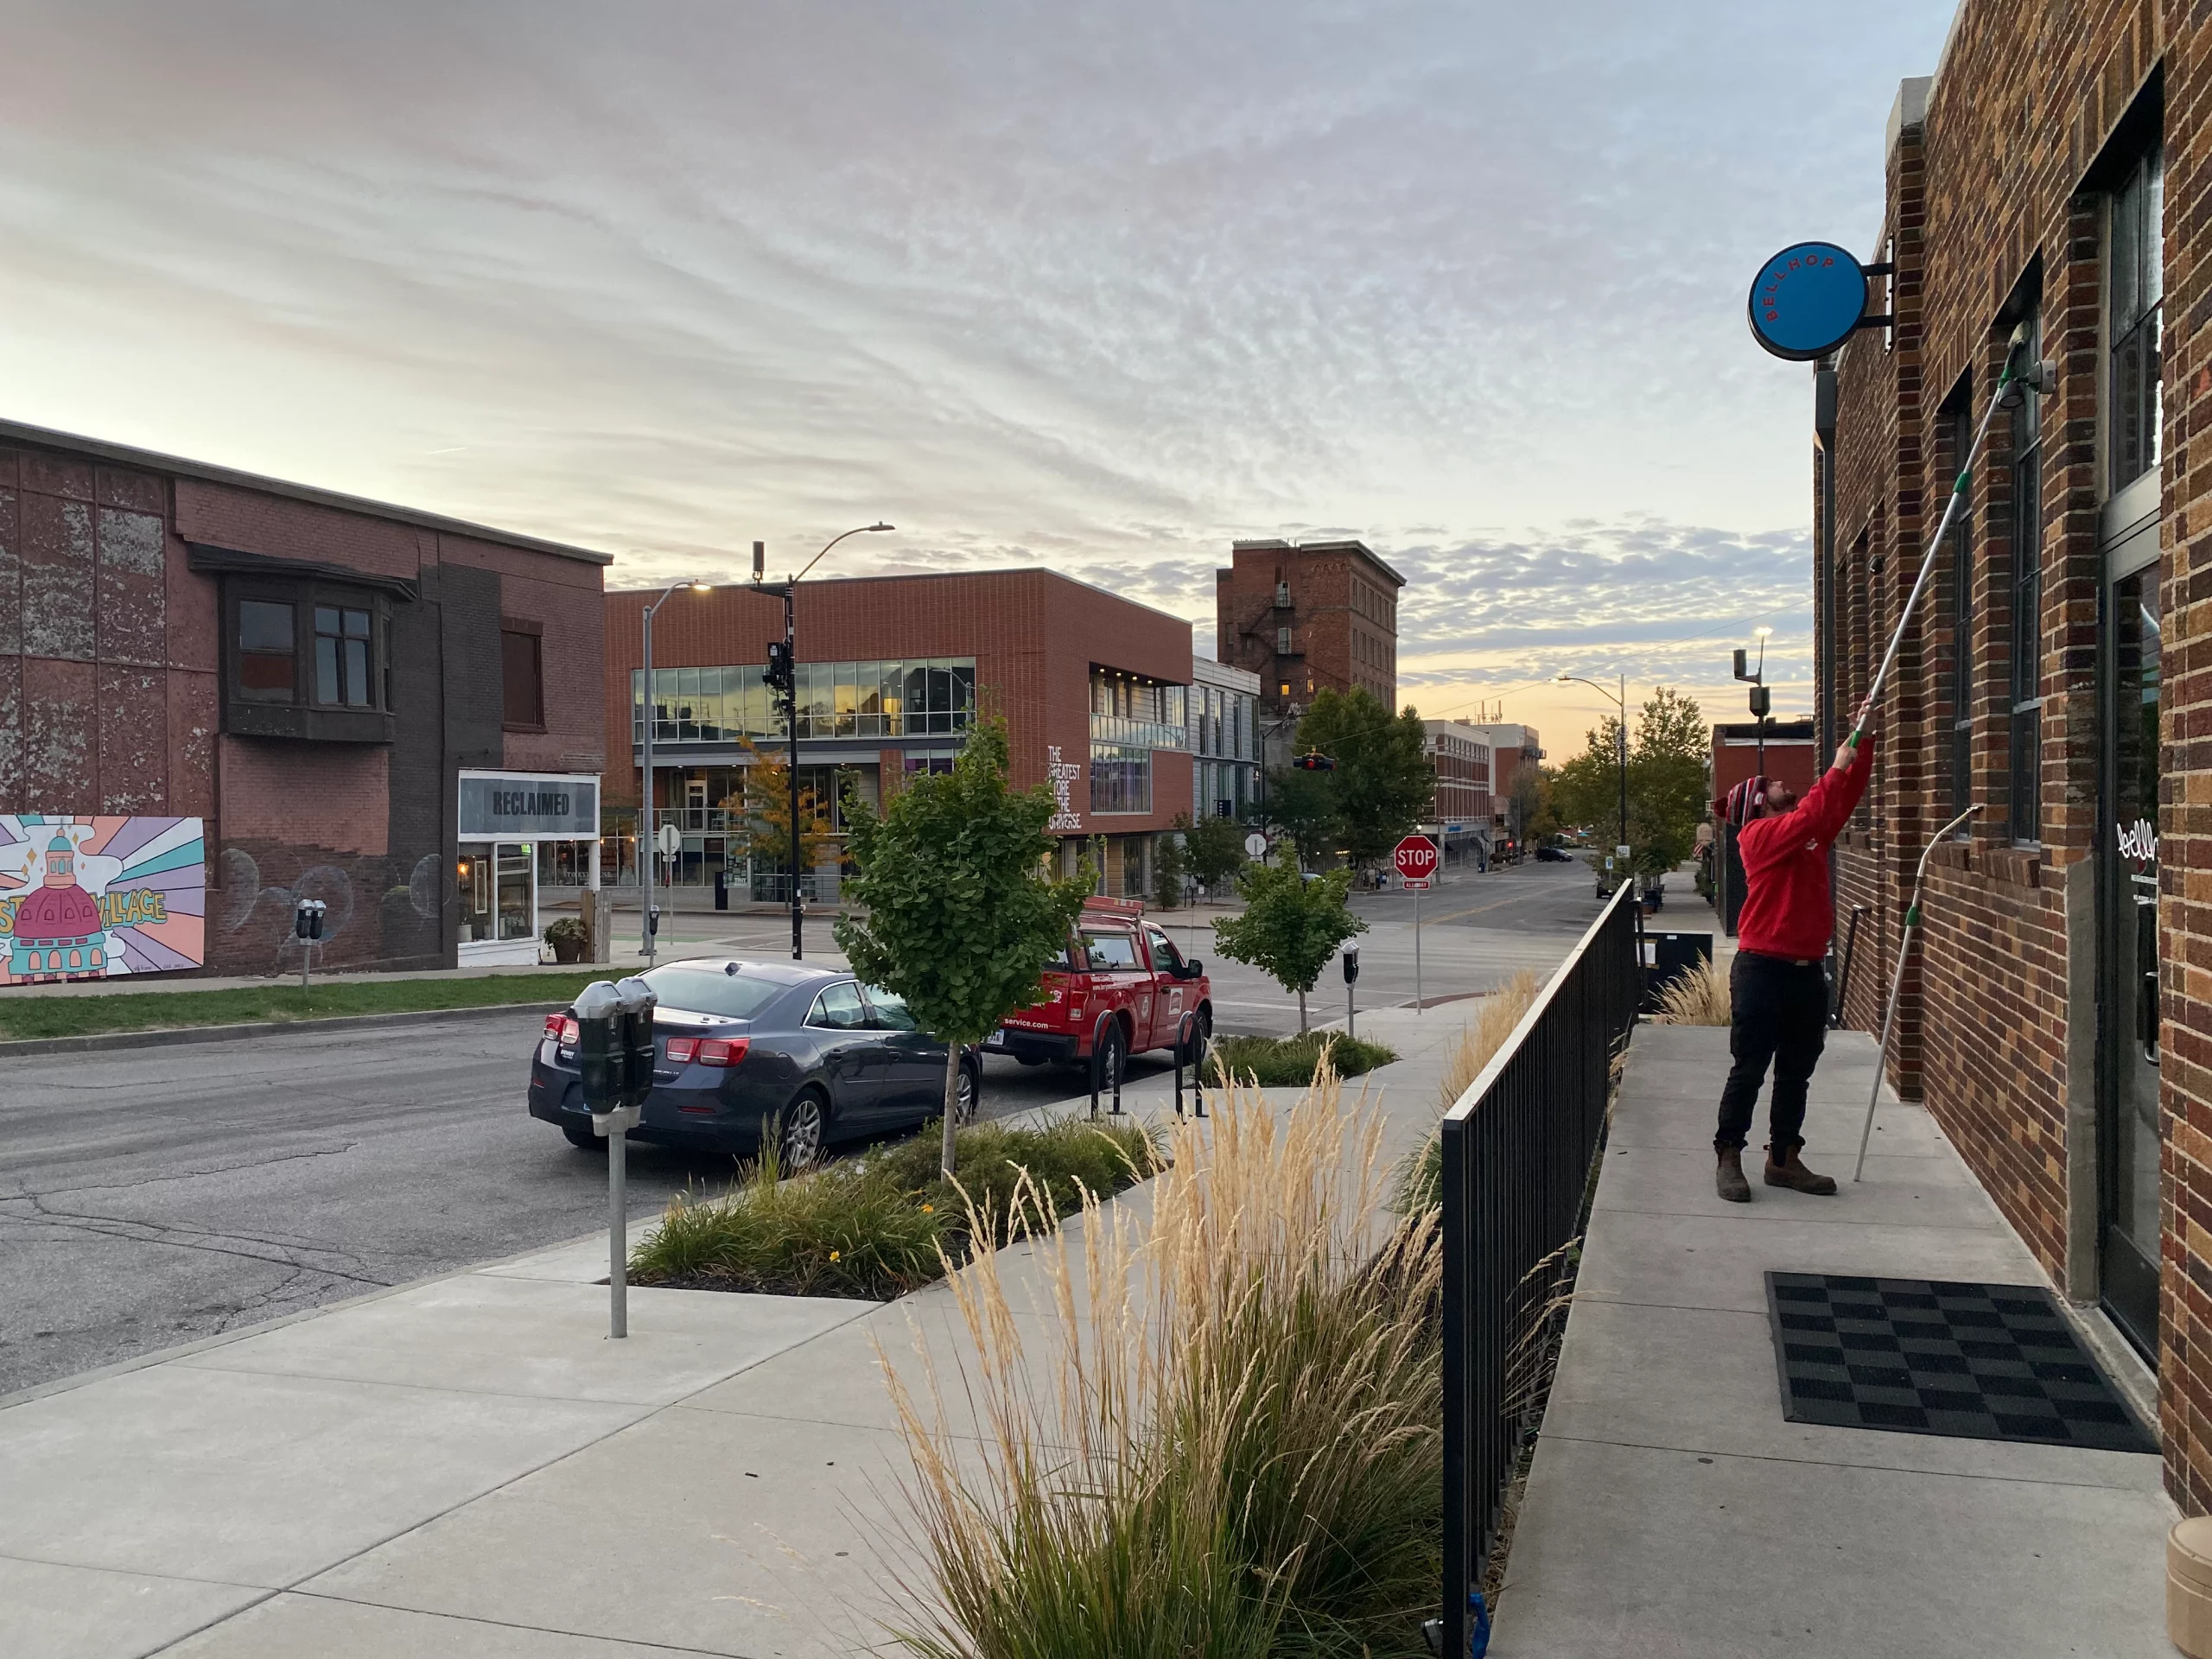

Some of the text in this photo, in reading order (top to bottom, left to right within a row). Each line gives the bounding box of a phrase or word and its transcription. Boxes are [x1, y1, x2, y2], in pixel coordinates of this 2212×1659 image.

[1762, 254, 1834, 322] BELLHOP
[1048, 746, 1062, 762] THE
[1049, 779, 1070, 796] TORE
[493, 791, 569, 816] RECLAIMED
[1057, 797, 1071, 812] THE
[1397, 849, 1434, 866] STOP
[89, 888, 167, 927] VILLAGE
